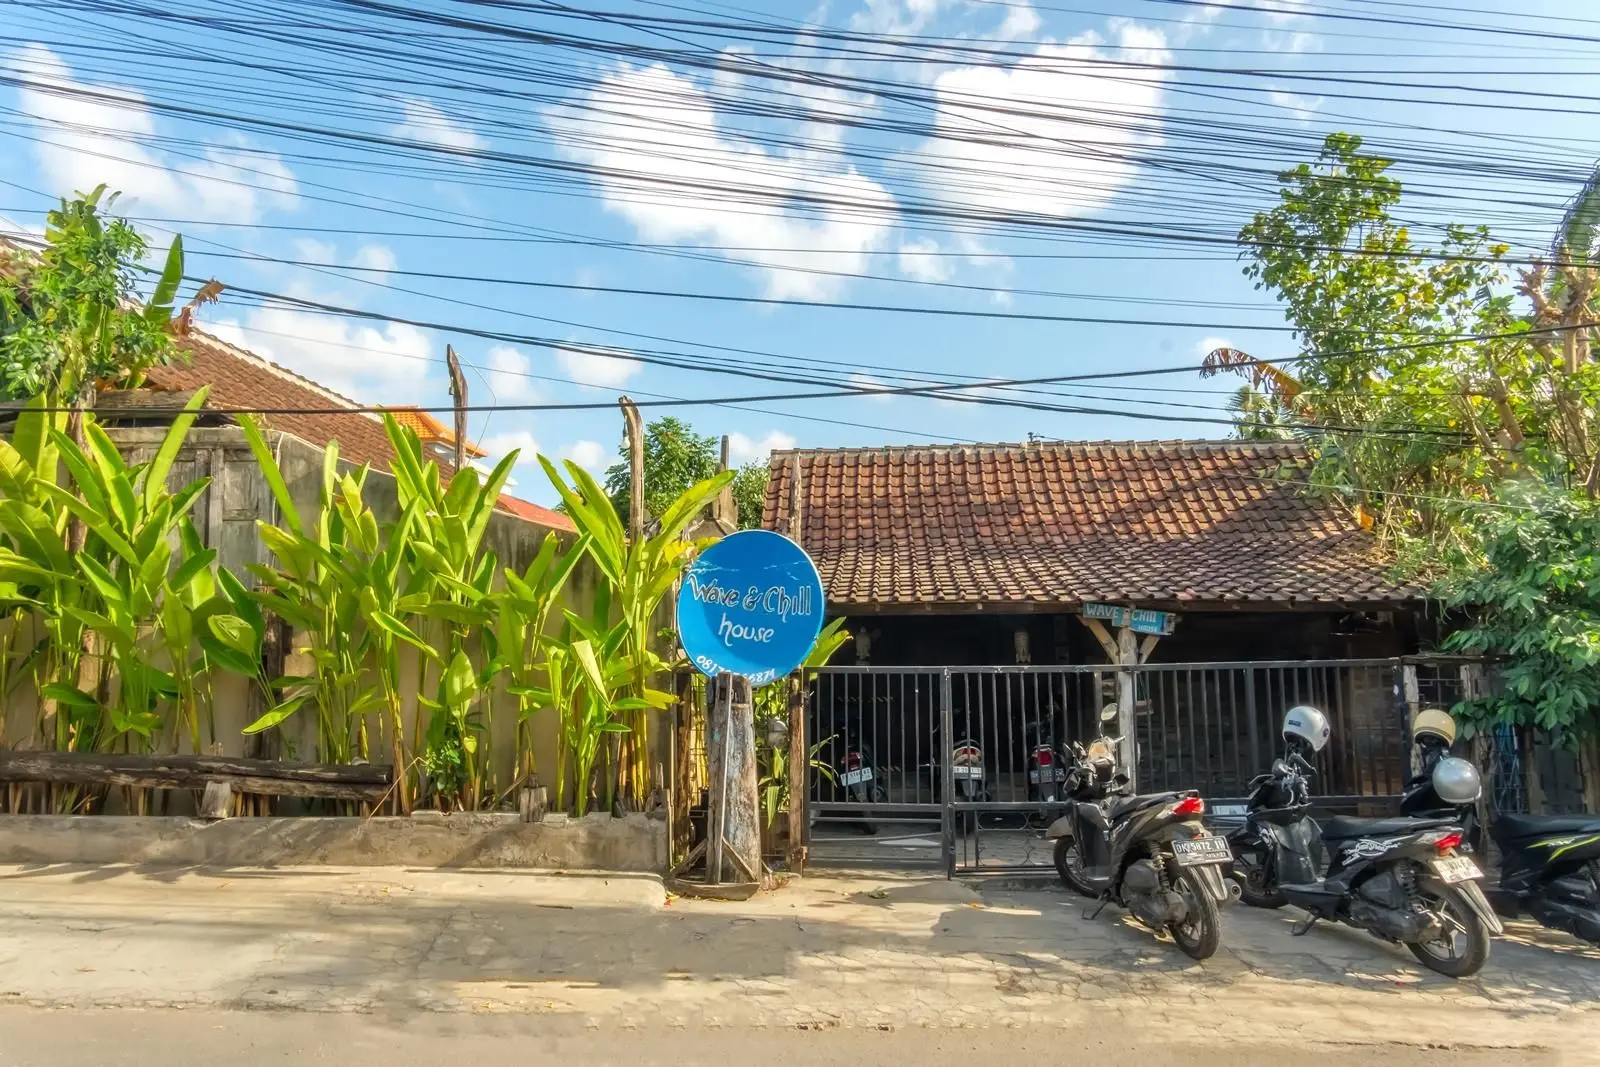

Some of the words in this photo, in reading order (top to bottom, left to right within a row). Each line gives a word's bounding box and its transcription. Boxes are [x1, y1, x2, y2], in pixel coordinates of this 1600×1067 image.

[687, 573, 740, 608] Wave
[742, 586, 763, 612] &
[763, 586, 812, 624] Chill
[1085, 603, 1119, 618] WAVE
[718, 612, 775, 647] house
